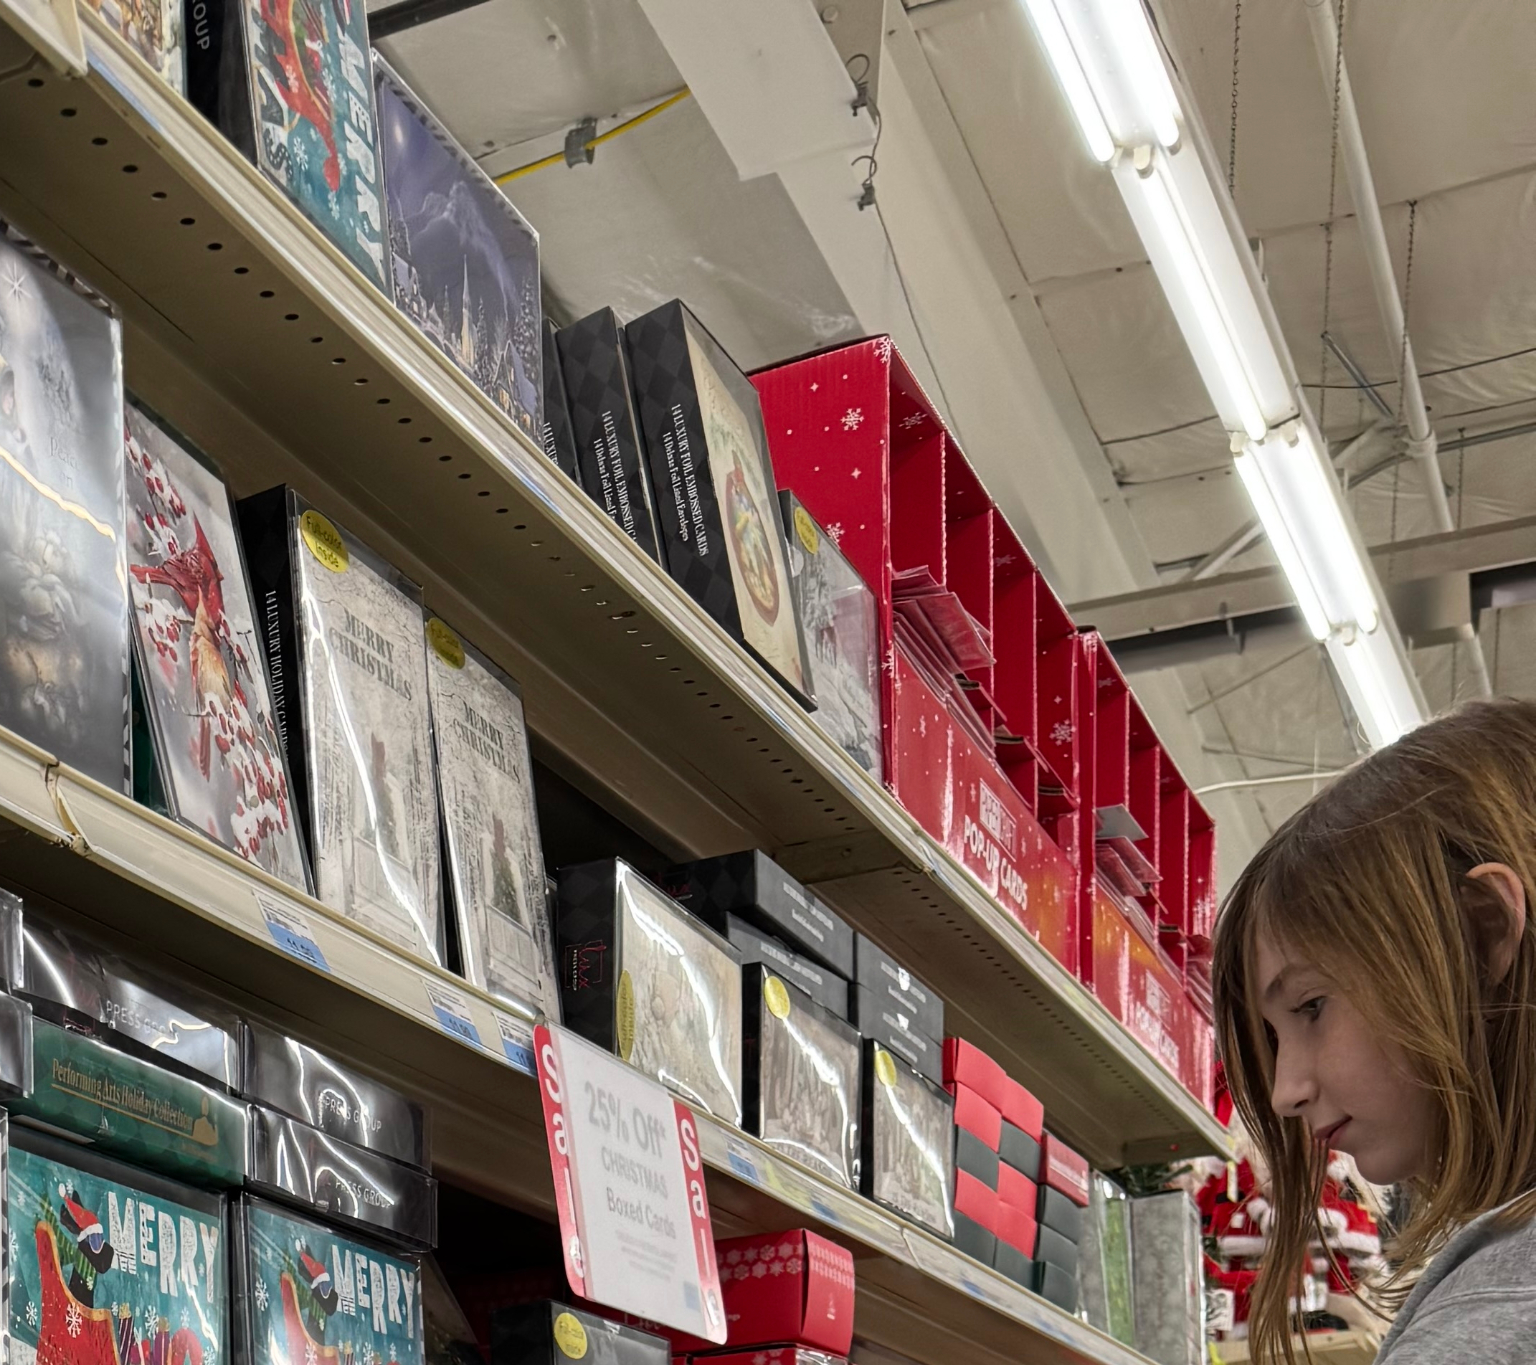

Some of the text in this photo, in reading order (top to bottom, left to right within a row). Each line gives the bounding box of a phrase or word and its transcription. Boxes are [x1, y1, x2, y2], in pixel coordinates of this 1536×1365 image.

[266, 603, 282, 655] LUXURY
[344, 606, 394, 664] MERRY
[1000, 857, 1029, 911] CARDS
[51, 1057, 103, 1101] Performing
[102, 1079, 122, 1104] Arts
[120, 1084, 154, 1114] Holiday
[584, 1081, 630, 1145] 25%
[600, 1146, 670, 1201] CHRISTMAS
[606, 1186, 677, 1240] Boxed Cards
[106, 1190, 221, 1304] MERRY
[330, 1242, 418, 1340] MERRY
